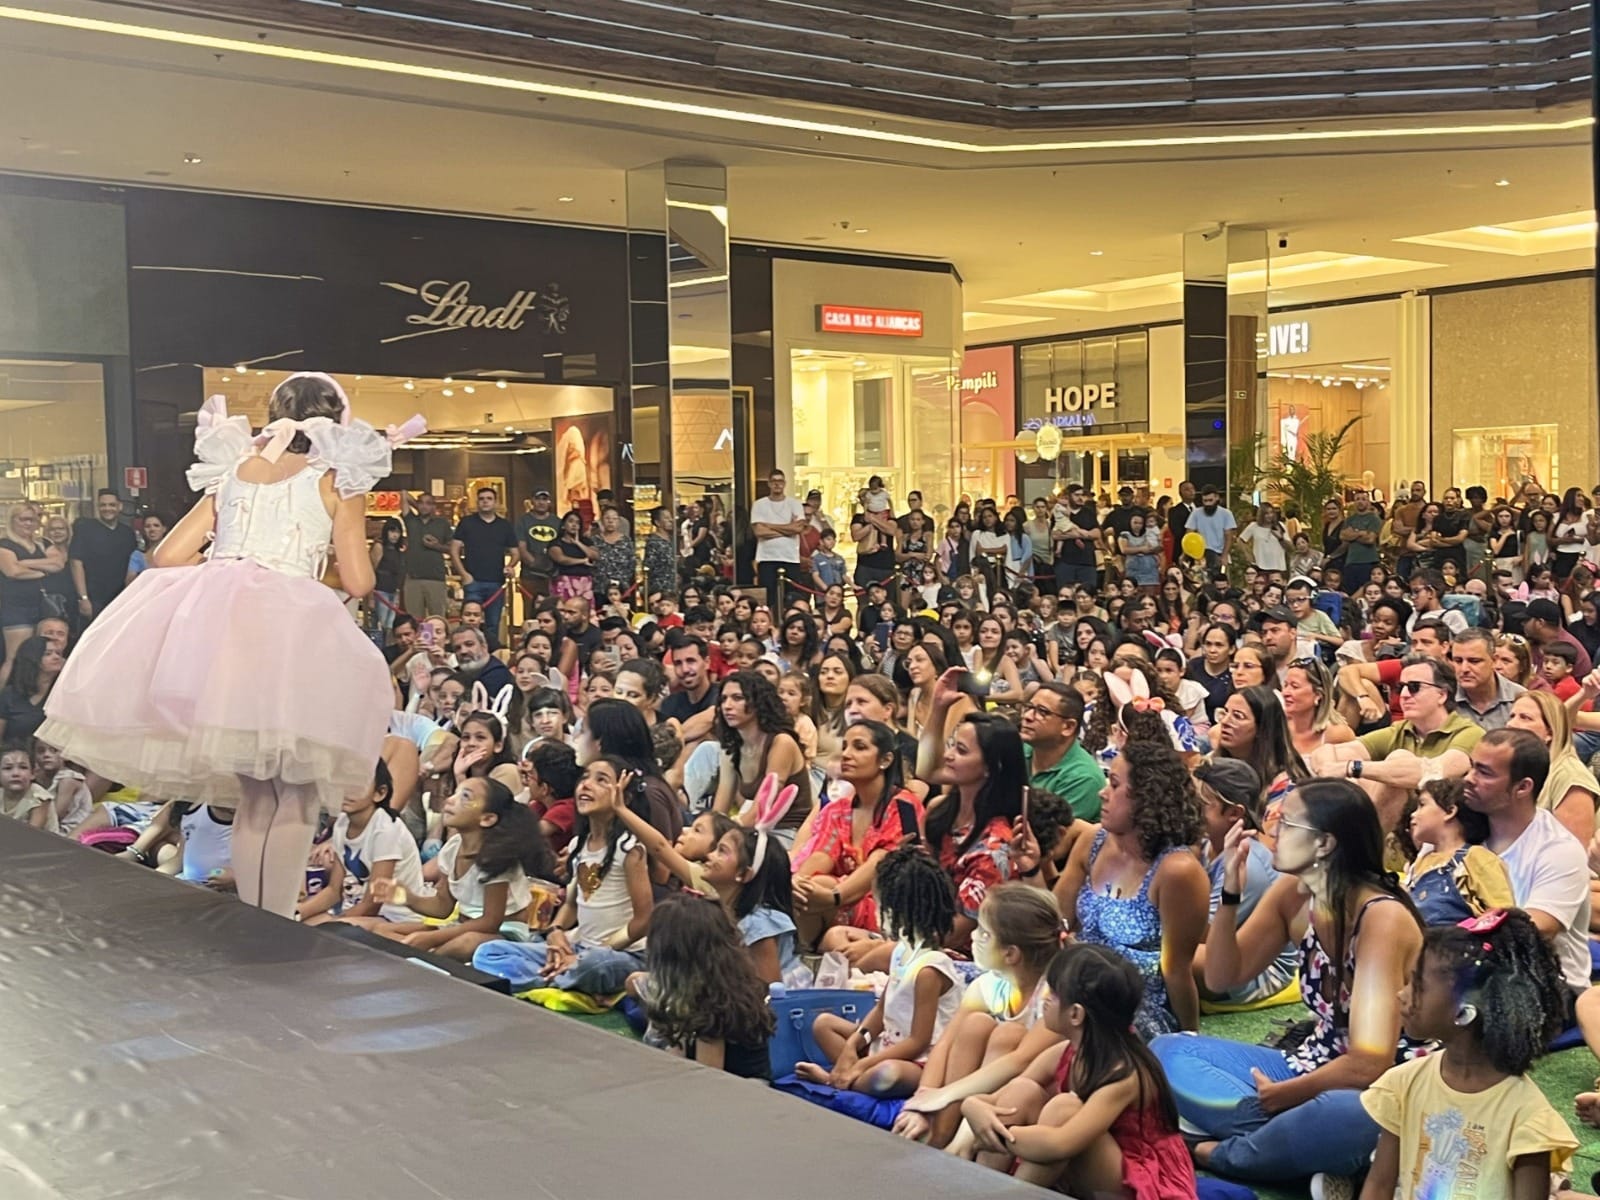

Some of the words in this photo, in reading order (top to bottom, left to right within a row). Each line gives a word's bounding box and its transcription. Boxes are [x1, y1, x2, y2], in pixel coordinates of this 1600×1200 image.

[406, 280, 537, 331] Lindt
[824, 311, 851, 327] CASA
[853, 313, 873, 328] DAS
[875, 315, 922, 332] ALIANÇAS
[1267, 321, 1308, 356] IVE!
[945, 371, 997, 394] Pampili
[1045, 382, 1116, 413] HOPE
